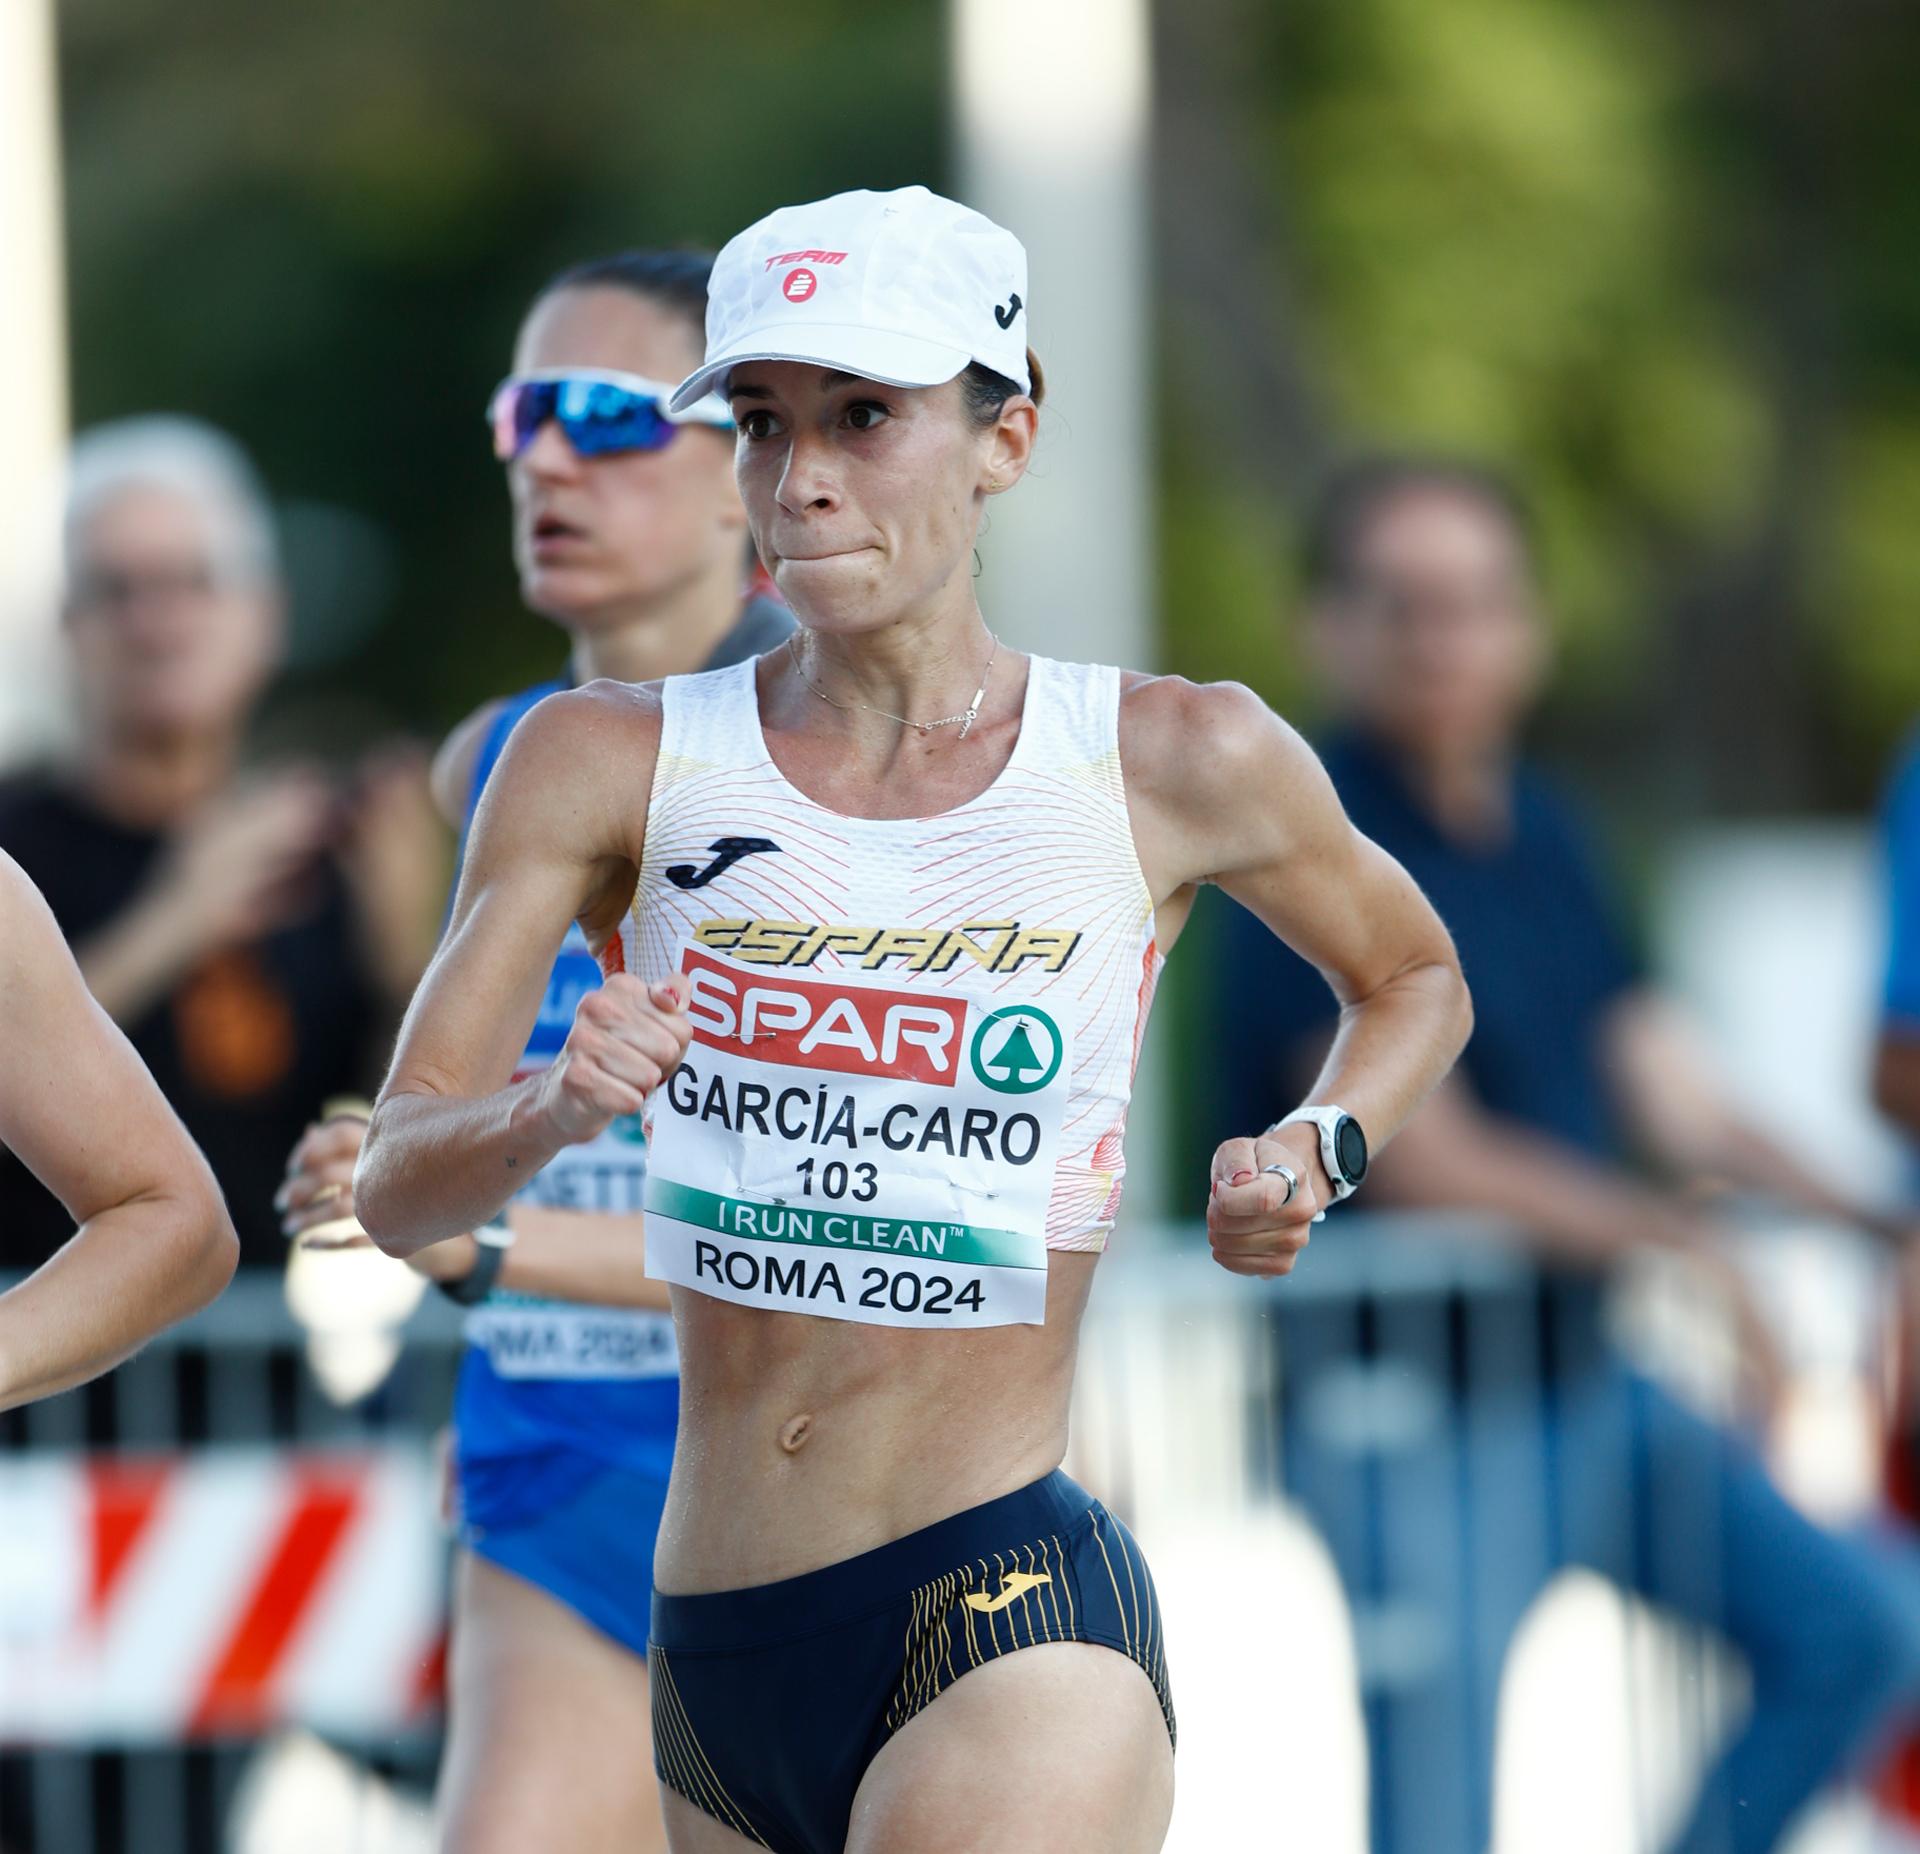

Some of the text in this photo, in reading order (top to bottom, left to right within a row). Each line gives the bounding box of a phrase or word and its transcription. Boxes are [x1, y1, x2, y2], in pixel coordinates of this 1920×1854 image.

[765, 250, 848, 272] TEAM
[693, 919, 1083, 972] ESPAÑA
[687, 967, 955, 1073] SPAR
[667, 1062, 1041, 1166] GARCÍA-CARO
[796, 1156, 879, 1202] 103
[718, 1201, 726, 1227] I
[735, 1205, 813, 1240] RUN
[696, 1240, 986, 1315] ROMA 2024
